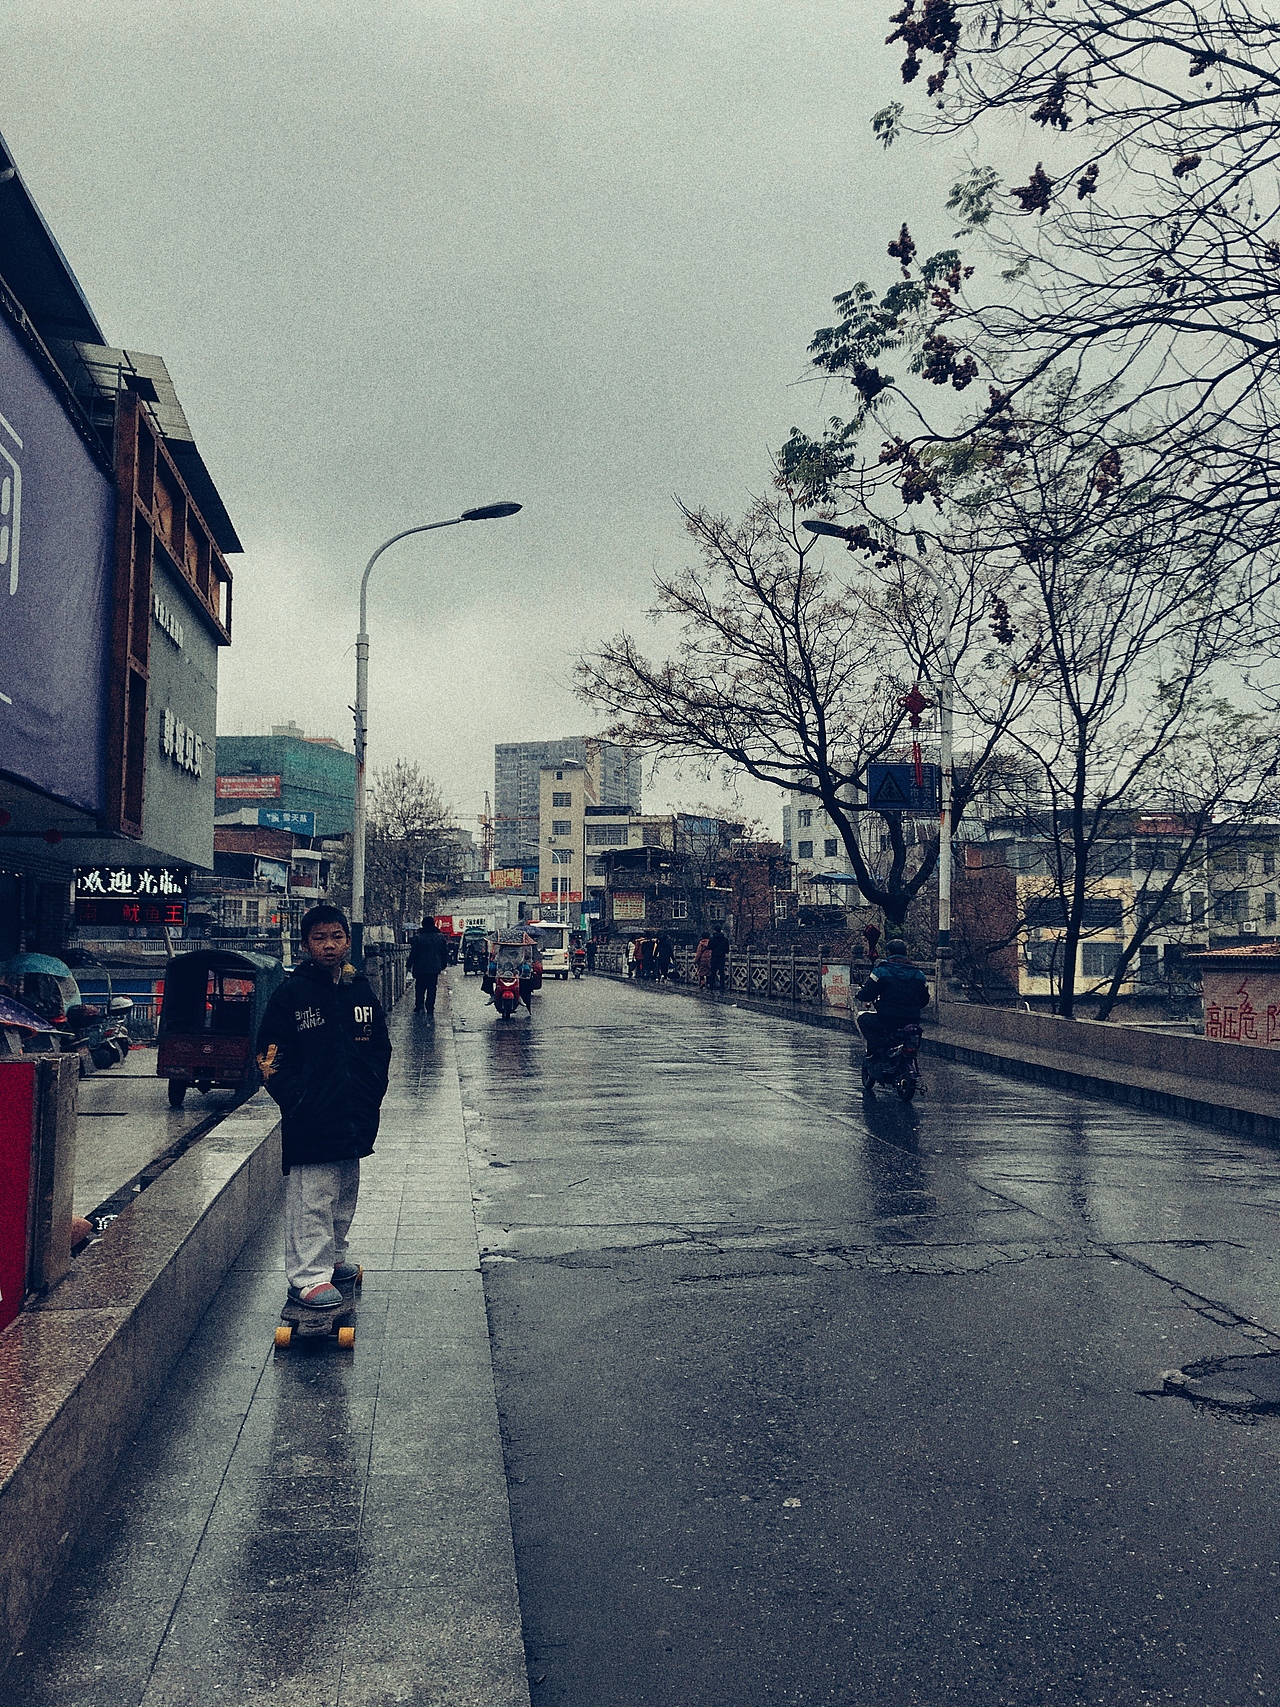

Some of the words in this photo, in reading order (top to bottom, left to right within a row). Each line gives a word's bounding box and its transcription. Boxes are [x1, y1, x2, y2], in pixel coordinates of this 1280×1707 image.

[922, 766, 932, 809] 注意安全
[80, 869, 183, 895] 欢迎光临
[122, 903, 183, 923] 鱿鱼王
